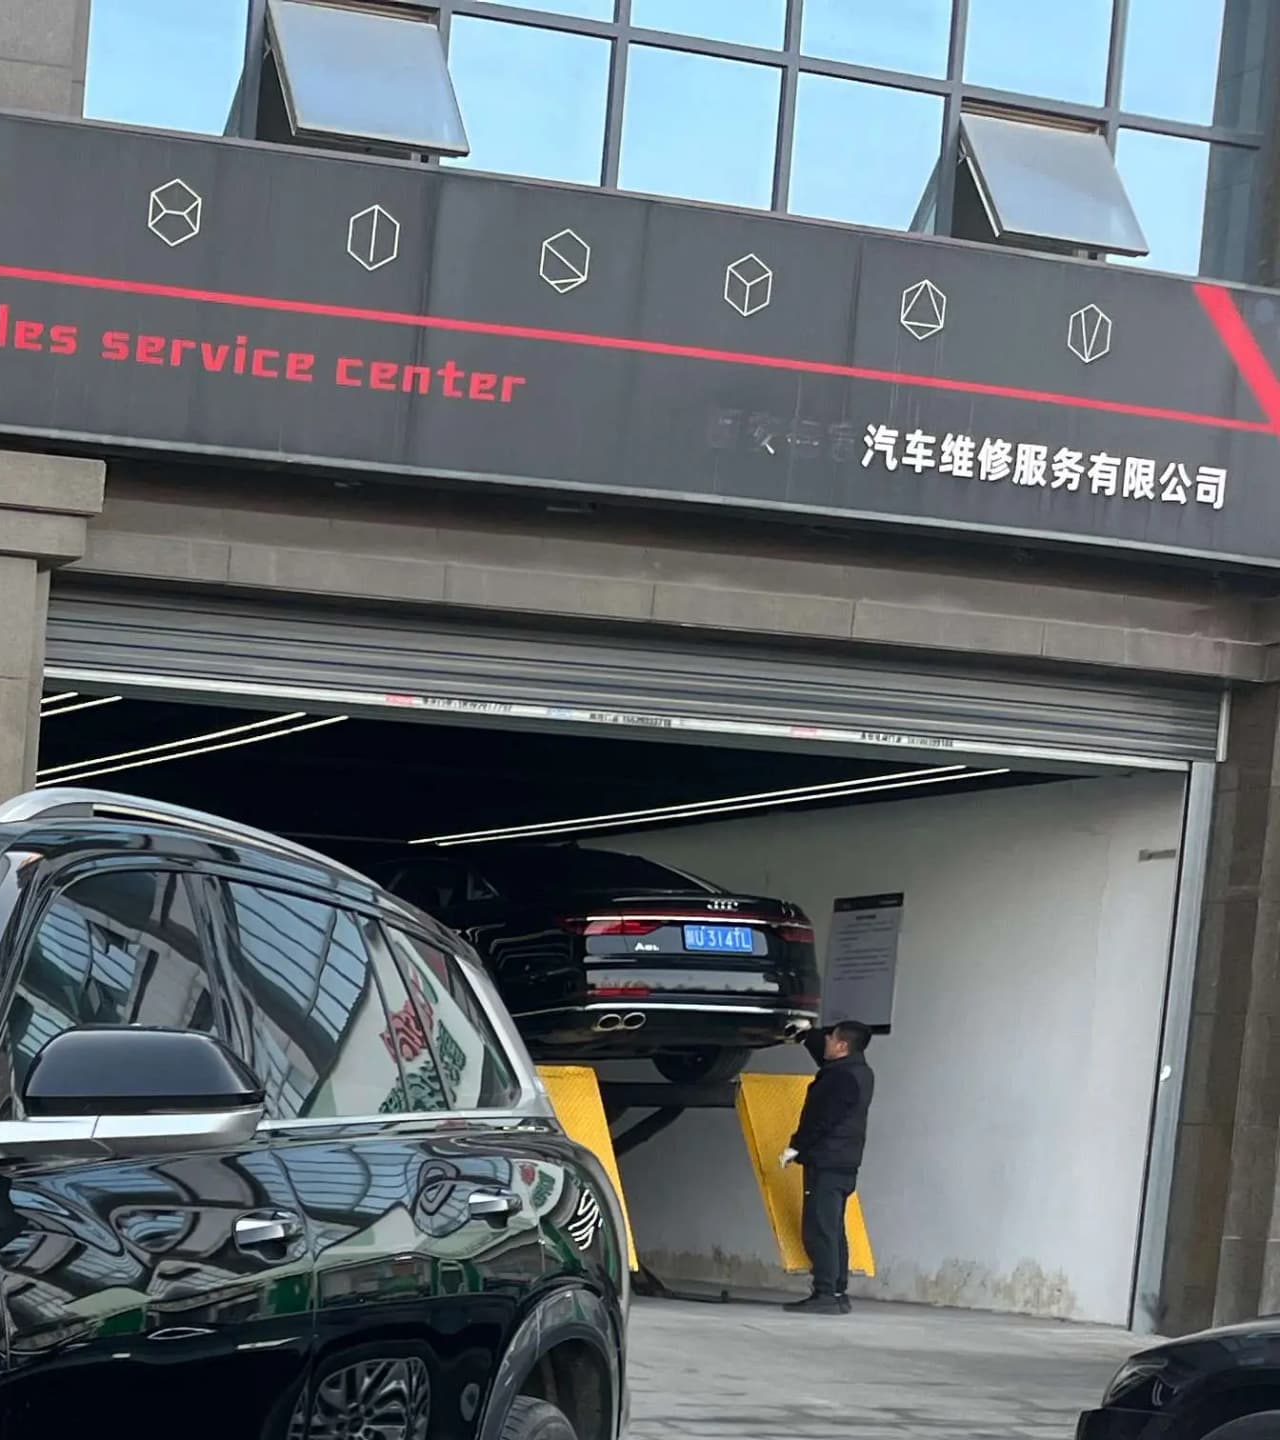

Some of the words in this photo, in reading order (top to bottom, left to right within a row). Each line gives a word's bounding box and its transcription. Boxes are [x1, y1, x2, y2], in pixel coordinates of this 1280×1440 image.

[102, 335, 315, 381] service
[336, 357, 526, 403] center
[861, 423, 1228, 511] 汽车维修服务有限公司
